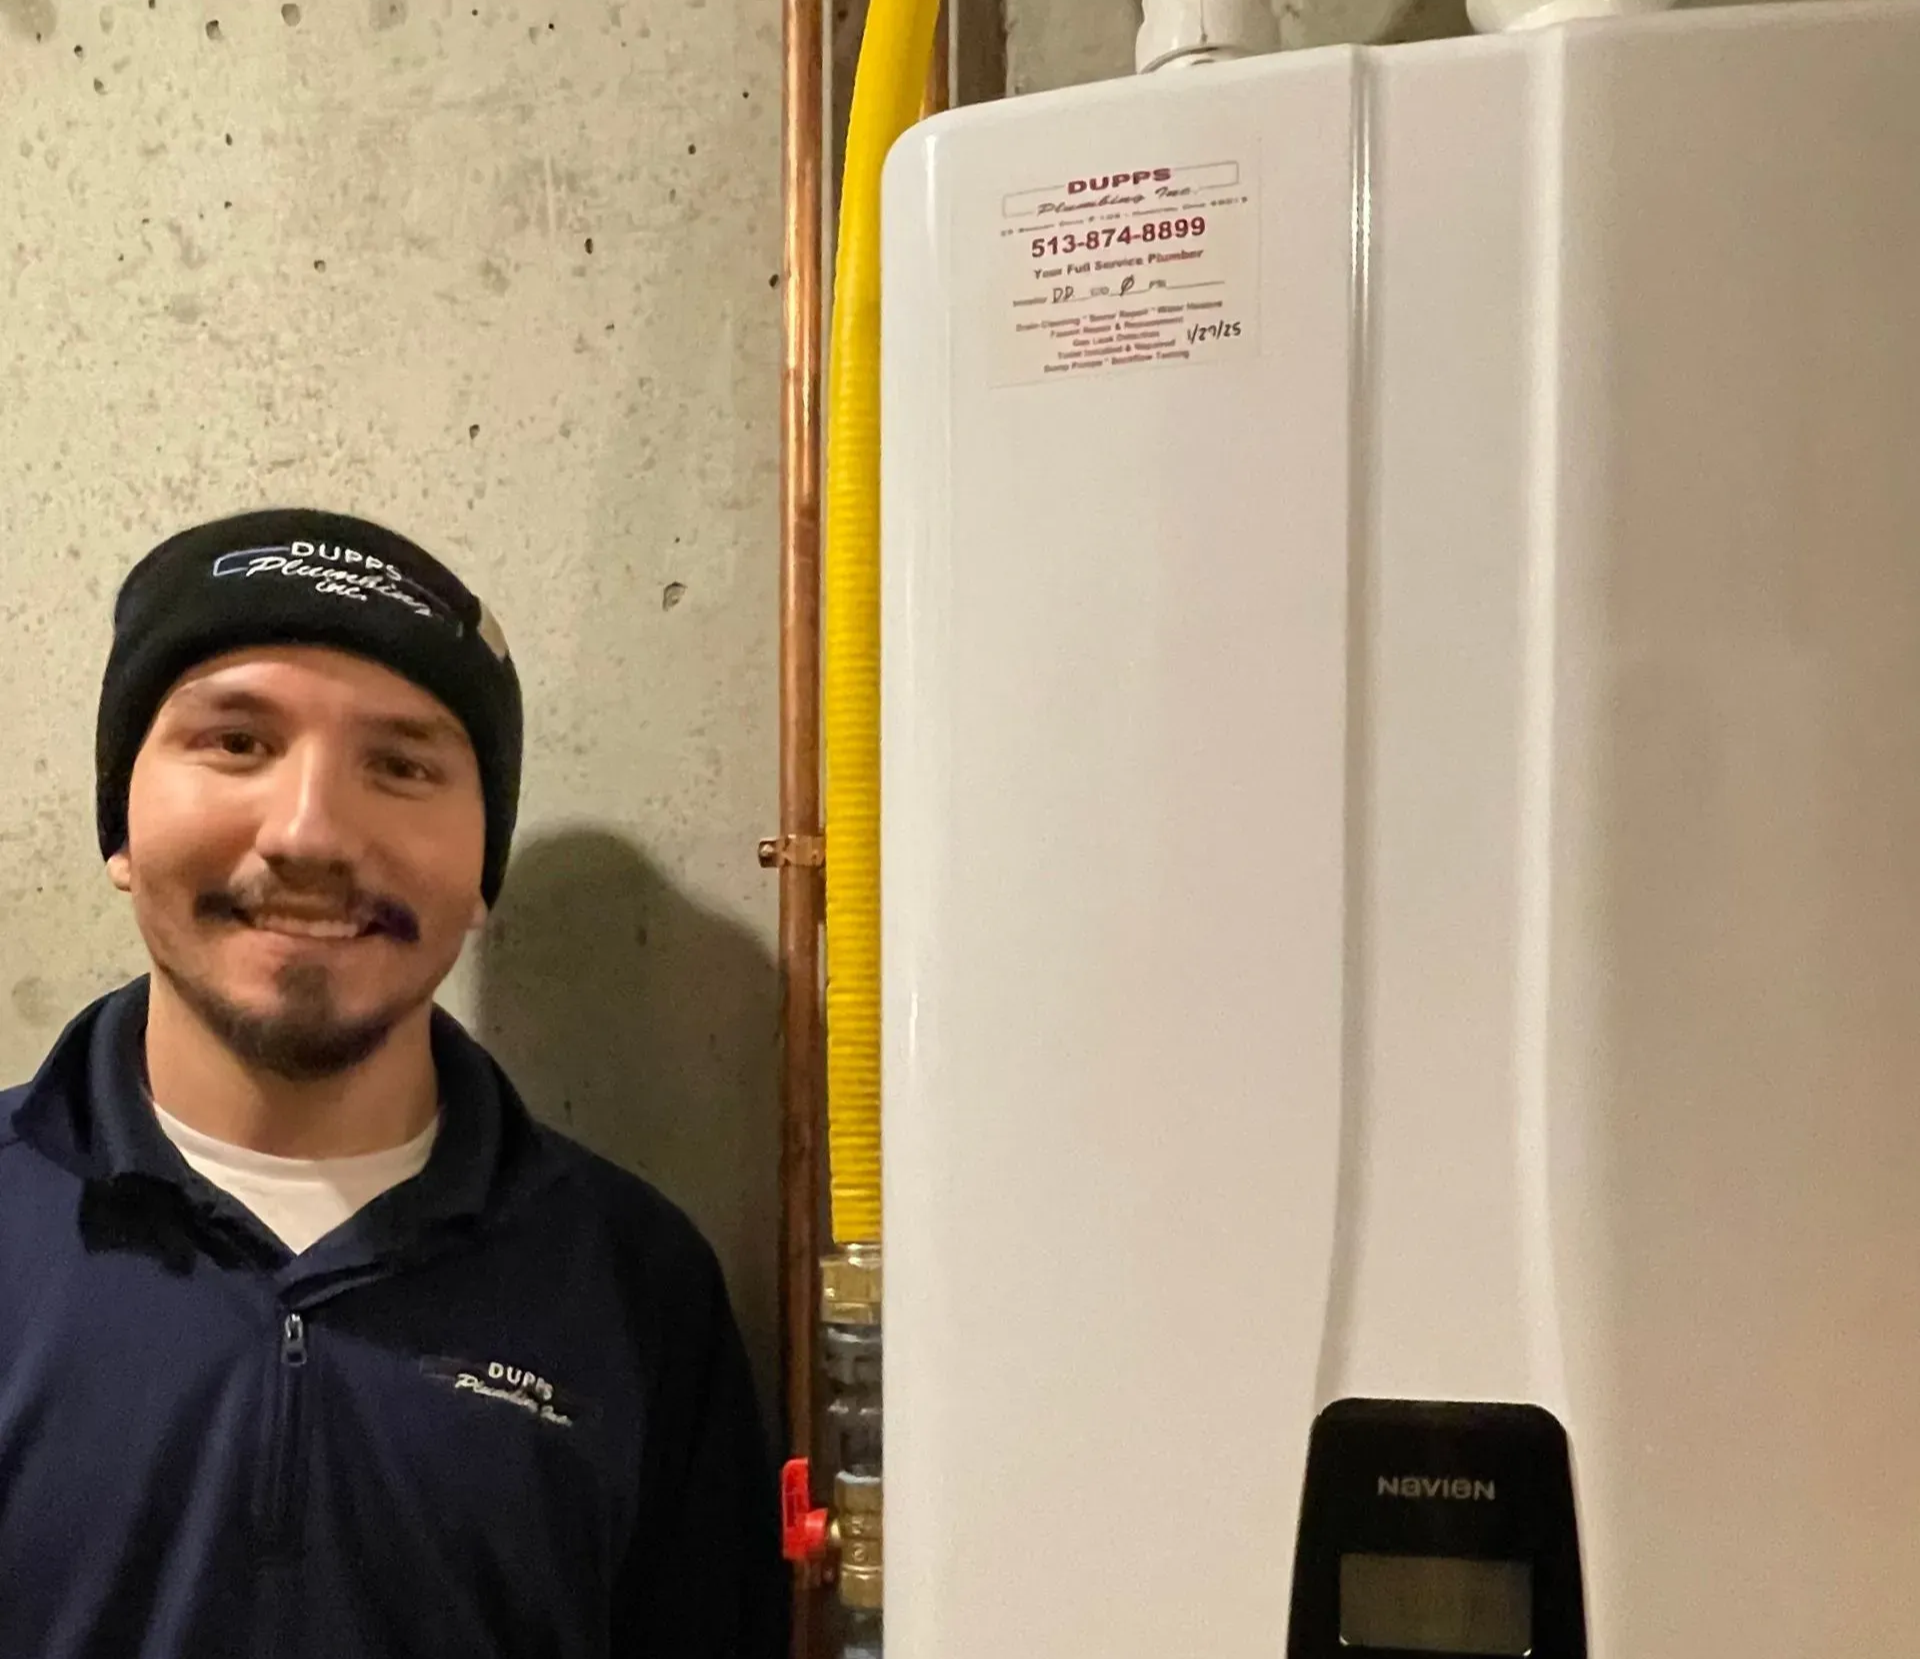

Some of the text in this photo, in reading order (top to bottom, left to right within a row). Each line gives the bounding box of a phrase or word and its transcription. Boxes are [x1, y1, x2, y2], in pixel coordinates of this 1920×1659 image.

[1067, 168, 1172, 195] DUPPS
[1036, 194, 1145, 217] Plumbing
[1031, 216, 1207, 258] 513-874-8899
[1067, 261, 1091, 275] Full
[1095, 257, 1143, 270] Service
[1148, 248, 1204, 264] Plumber
[291, 541, 402, 581] DUPPS
[245, 556, 432, 616] Plumbing
[488, 1361, 554, 1401] DUPPS
